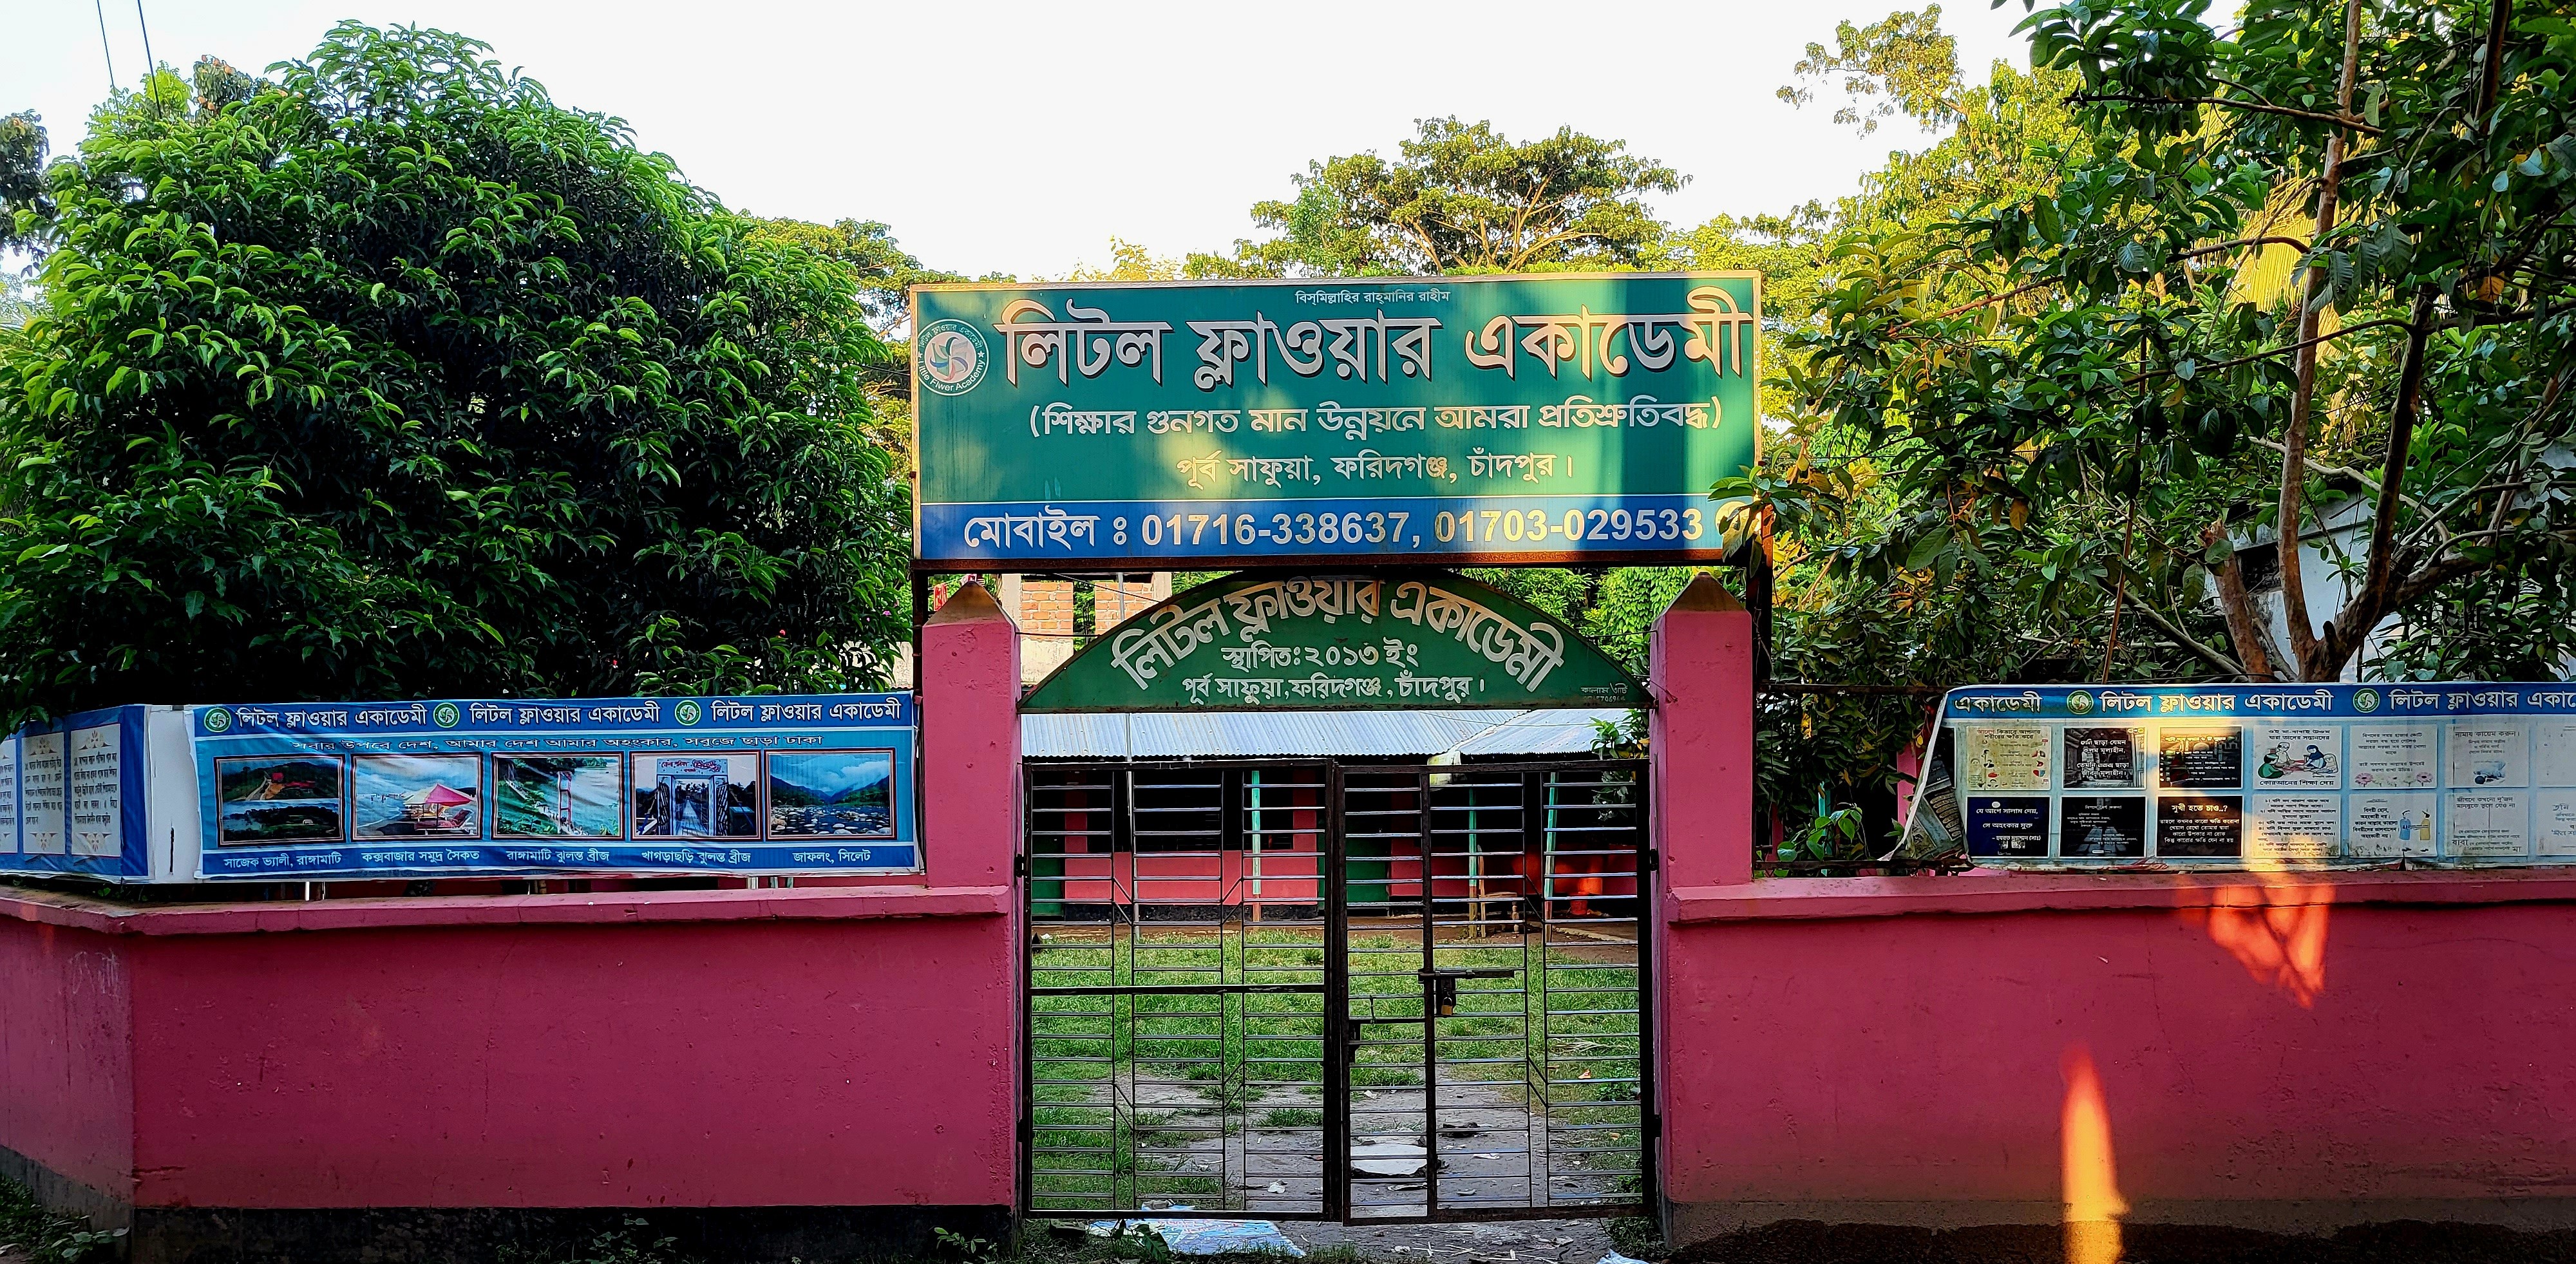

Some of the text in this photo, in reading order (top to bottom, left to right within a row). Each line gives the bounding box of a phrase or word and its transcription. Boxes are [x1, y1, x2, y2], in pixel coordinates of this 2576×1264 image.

[1417, 288, 1451, 303] রাহীম
[993, 285, 1754, 391] লিটল ফ্লাওয়ার একাডেমী
[929, 379, 954, 391] Flwer
[955, 359, 985, 391] Academy
[1030, 402, 1136, 437] (শিক্ষার
[1146, 410, 1241, 435] গুনগত
[1248, 409, 1308, 433] মান
[1316, 401, 1426, 440] উন্নয়নে
[1434, 404, 1531, 429] আমরা
[1176, 449, 1222, 489] পূর্ব
[1226, 455, 1321, 488] সাফুয়া,
[1330, 449, 1458, 484] ফরিদগঞ্জ,
[965, 505, 1101, 551] মোবাইল
[1142, 511, 1421, 549] 01716-338637,
[1434, 509, 1703, 543] 01703-029533
[1111, 575, 1565, 693] লিটল ফ্লাওয়ার একাডেমী
[1383, 636, 1419, 668] ইং
[1182, 672, 1213, 706] পূর্ব
[1955, 692, 2043, 713] একাডেমী
[2099, 690, 2154, 712] লিটল
[2158, 693, 2235, 713] ফ্লাওয়ার
[2244, 689, 2334, 712] একাডেমী
[2389, 689, 2441, 710] লিটল
[2447, 690, 2519, 710] ফ্লাওয়ার
[236, 697, 902, 728] লিটল ফ্লাওয়ার একাডেমী লিটল ফ্লাওয়ার একাডেমী লিটল ফ্লাওয়ার একাডেমী
[292, 741, 335, 750] সবার
[340, 739, 390, 750] উপরে
[398, 740, 439, 751] দেশ,
[446, 739, 497, 748] আমার
[505, 739, 538, 748] দেশ
[545, 739, 597, 748] আমার
[783, 735, 824, 745] ঢাকা
[223, 851, 343, 869] সাজেক ভ্যালী, রাঙ্গামাটি
[361, 848, 480, 863] কক্সবাজার সমুদ্র সৈকত
[506, 848, 552, 861] রাঙ্গামাটি
[587, 848, 610, 862] ব্রীজ
[641, 849, 694, 863] খাগড়াছড়ি
[728, 849, 752, 864] ব্রীজ
[792, 849, 871, 864] জাফলং, সিলেট
